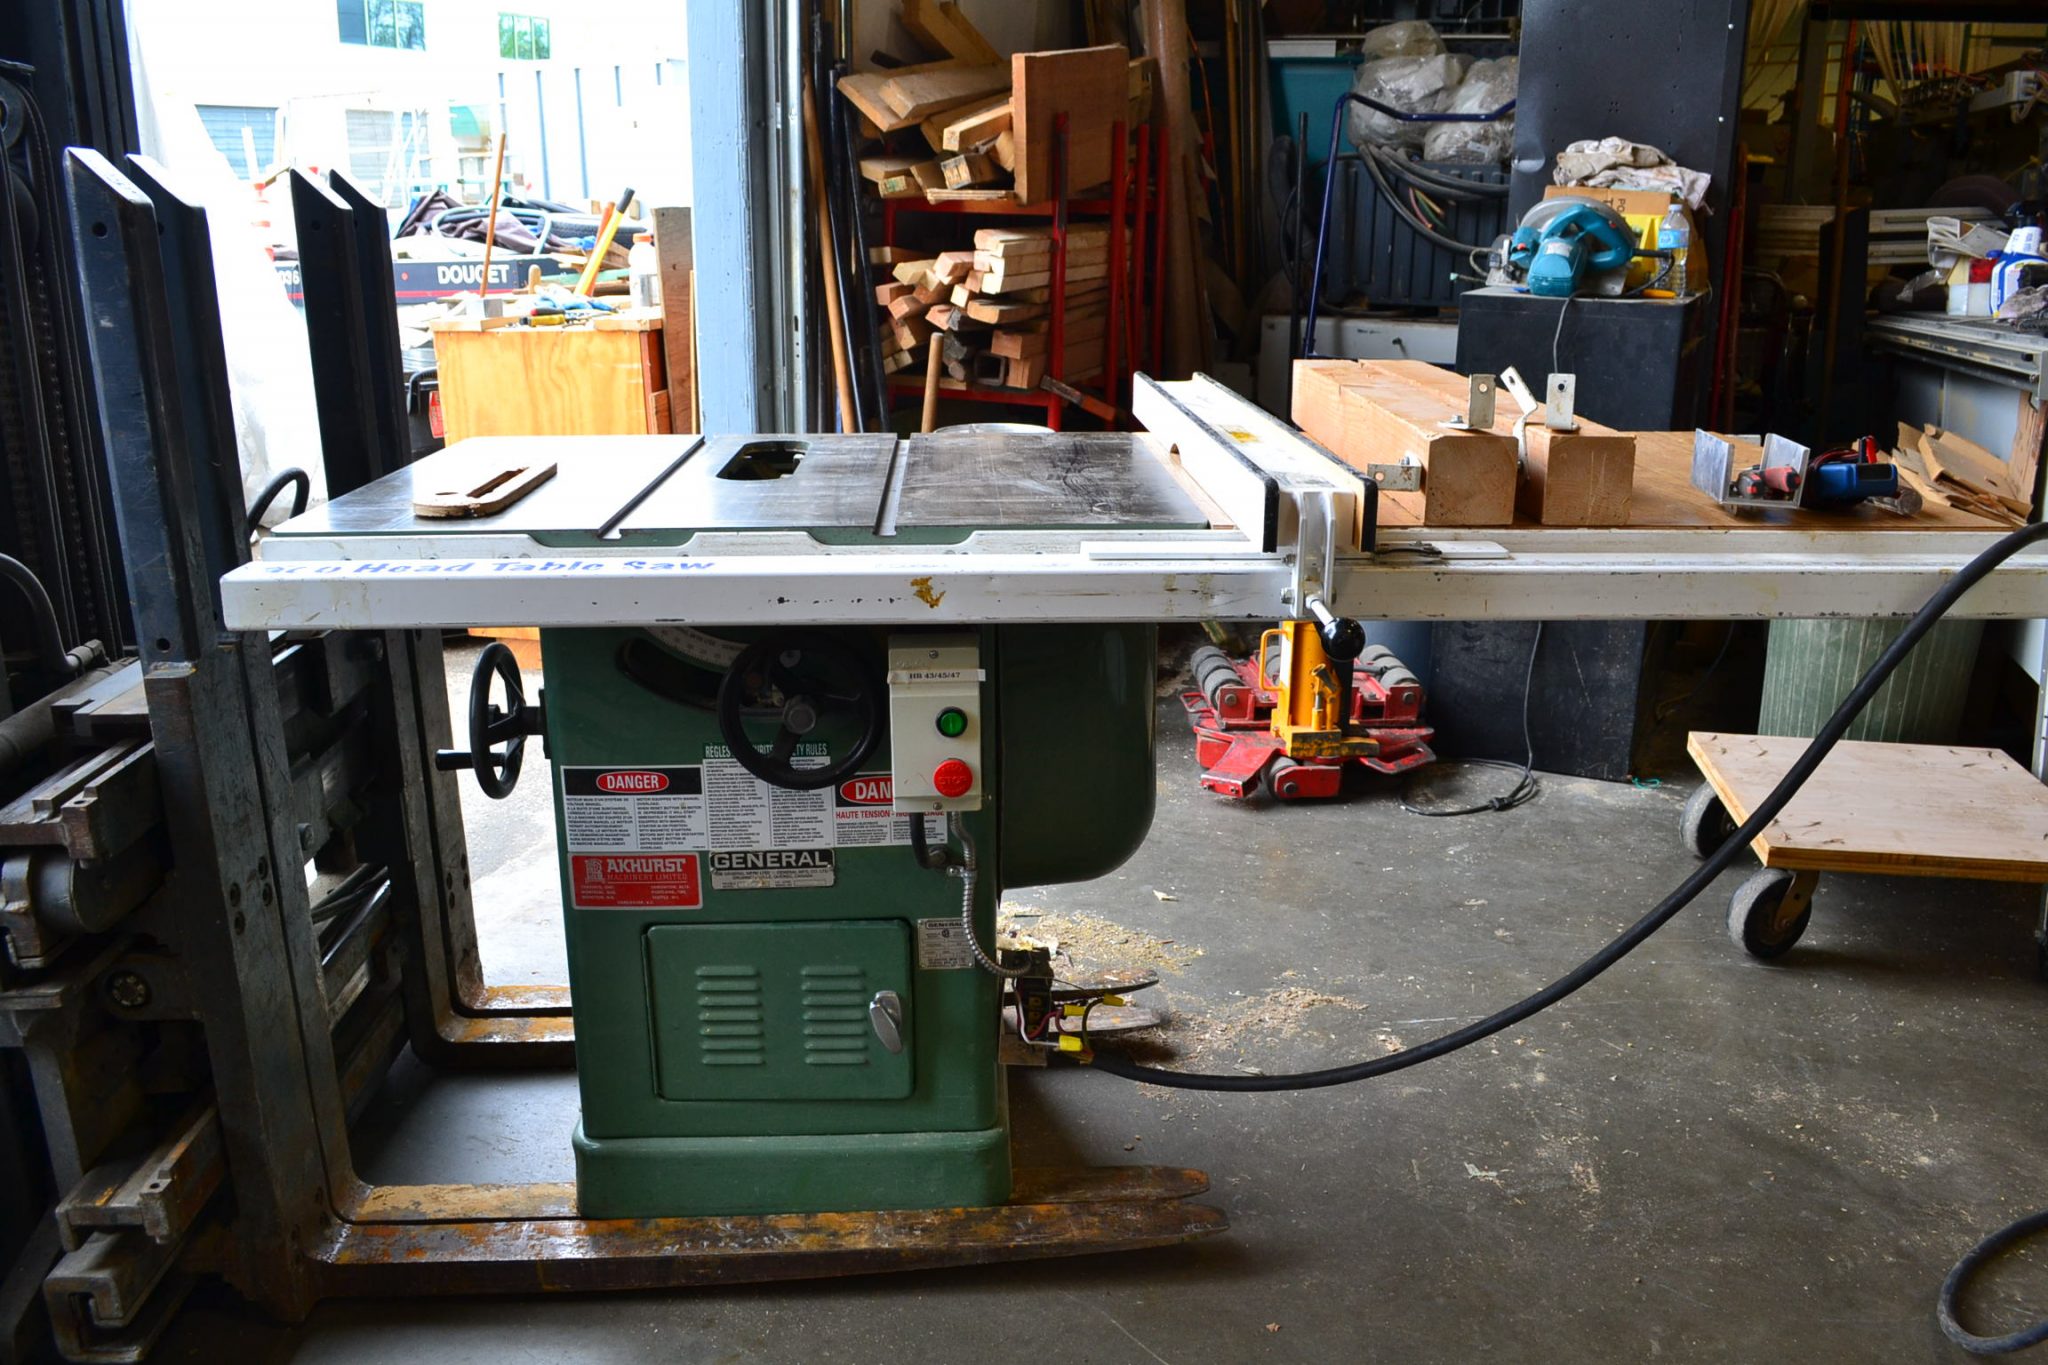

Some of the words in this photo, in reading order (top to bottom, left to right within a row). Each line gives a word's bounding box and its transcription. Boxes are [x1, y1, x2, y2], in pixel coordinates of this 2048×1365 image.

[805, 743, 827, 756] RULES
[606, 775, 660, 789] DANGER
[855, 781, 891, 799] DAN
[835, 811, 859, 820] HAUTE
[861, 810, 890, 818] TENSION
[607, 858, 686, 873] AKHURST
[714, 852, 828, 869] GENERAL
